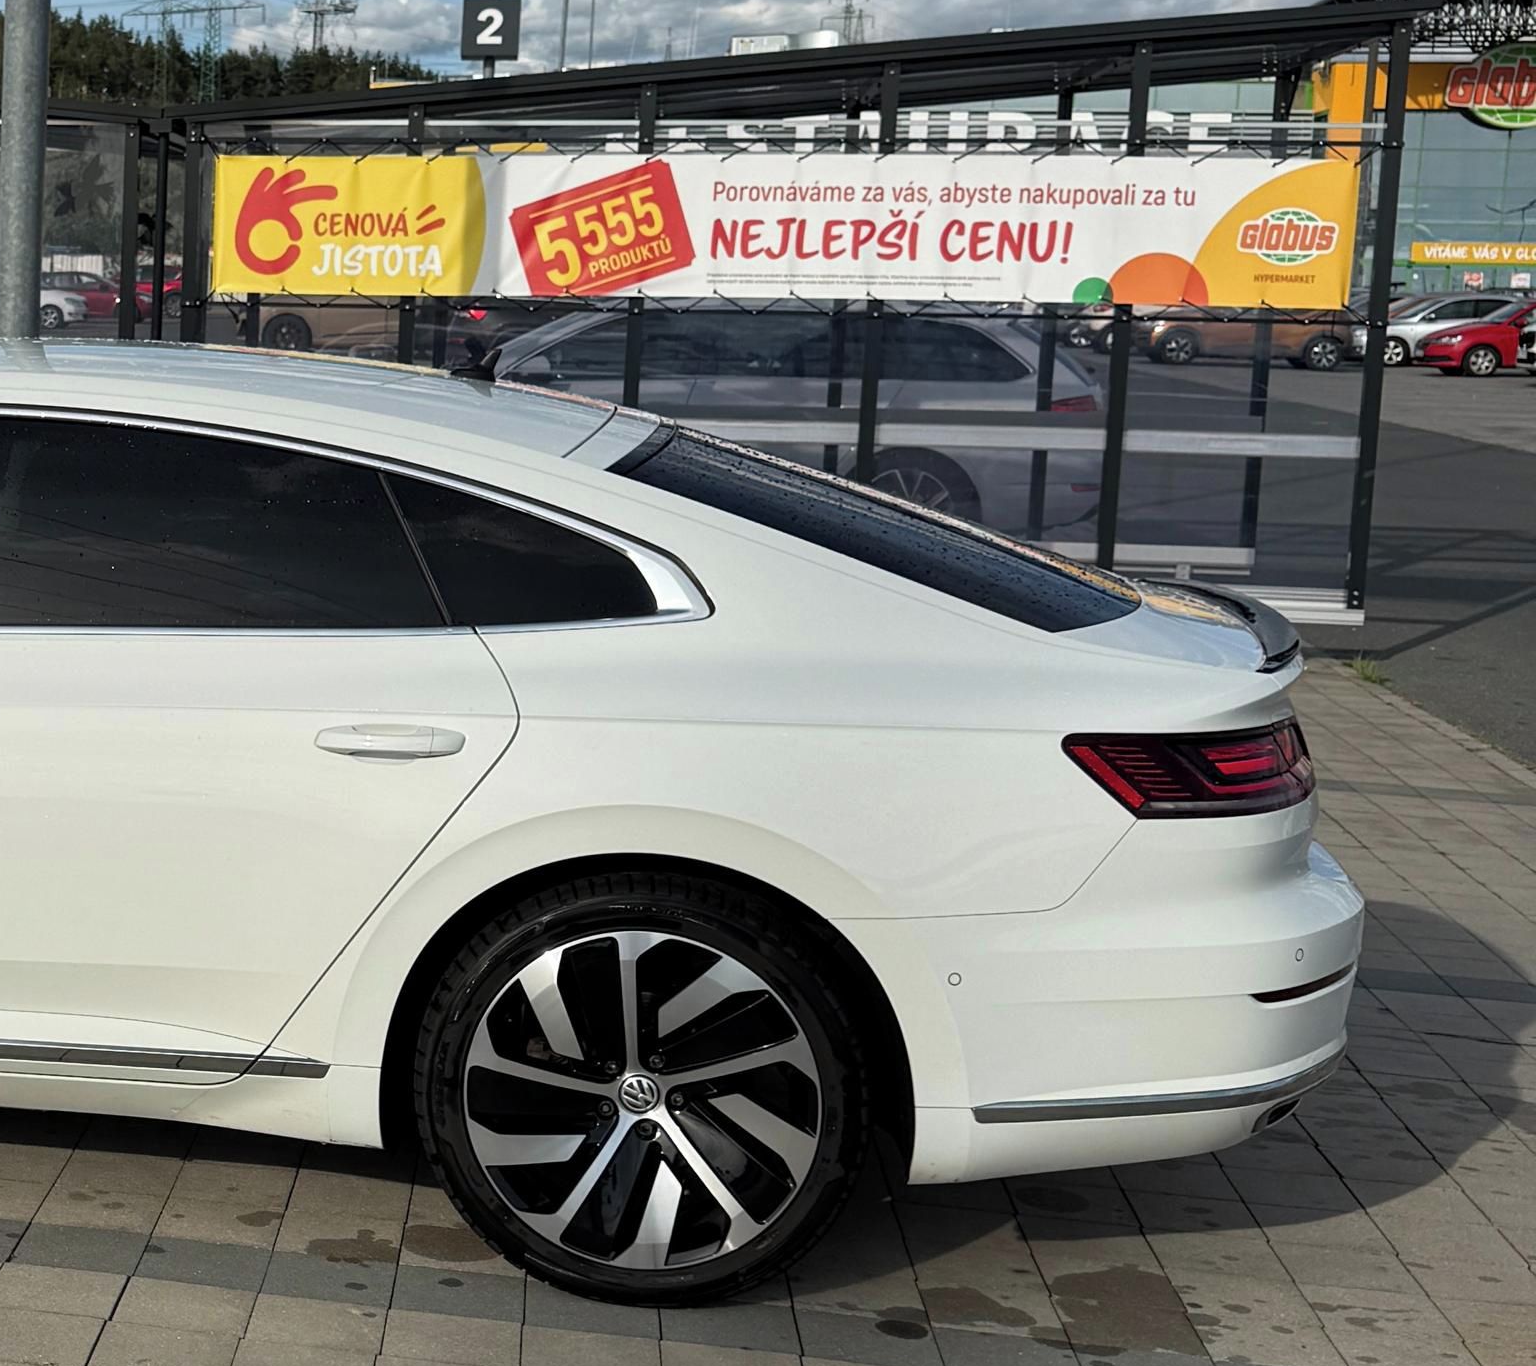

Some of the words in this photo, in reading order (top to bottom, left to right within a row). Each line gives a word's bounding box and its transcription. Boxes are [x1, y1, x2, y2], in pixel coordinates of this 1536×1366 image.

[476, 7, 504, 45] 2
[712, 180, 856, 203] Porovnáváme
[861, 185, 885, 203] za
[891, 180, 934, 207] vás,
[939, 181, 1012, 209] abyste
[1018, 182, 1137, 210] nakupovali
[1141, 188, 1166, 207] za
[1173, 186, 1197, 207] tu
[313, 207, 409, 238] CENOVÁ
[710, 209, 926, 262] NEJLEPŠÍ
[939, 219, 1074, 264] CENU!
[311, 242, 444, 278] JISTOTA
[588, 234, 673, 278] PRODUKTŮ
[1501, 245, 1513, 260] V
[1253, 274, 1316, 285] HYPERMARKET
